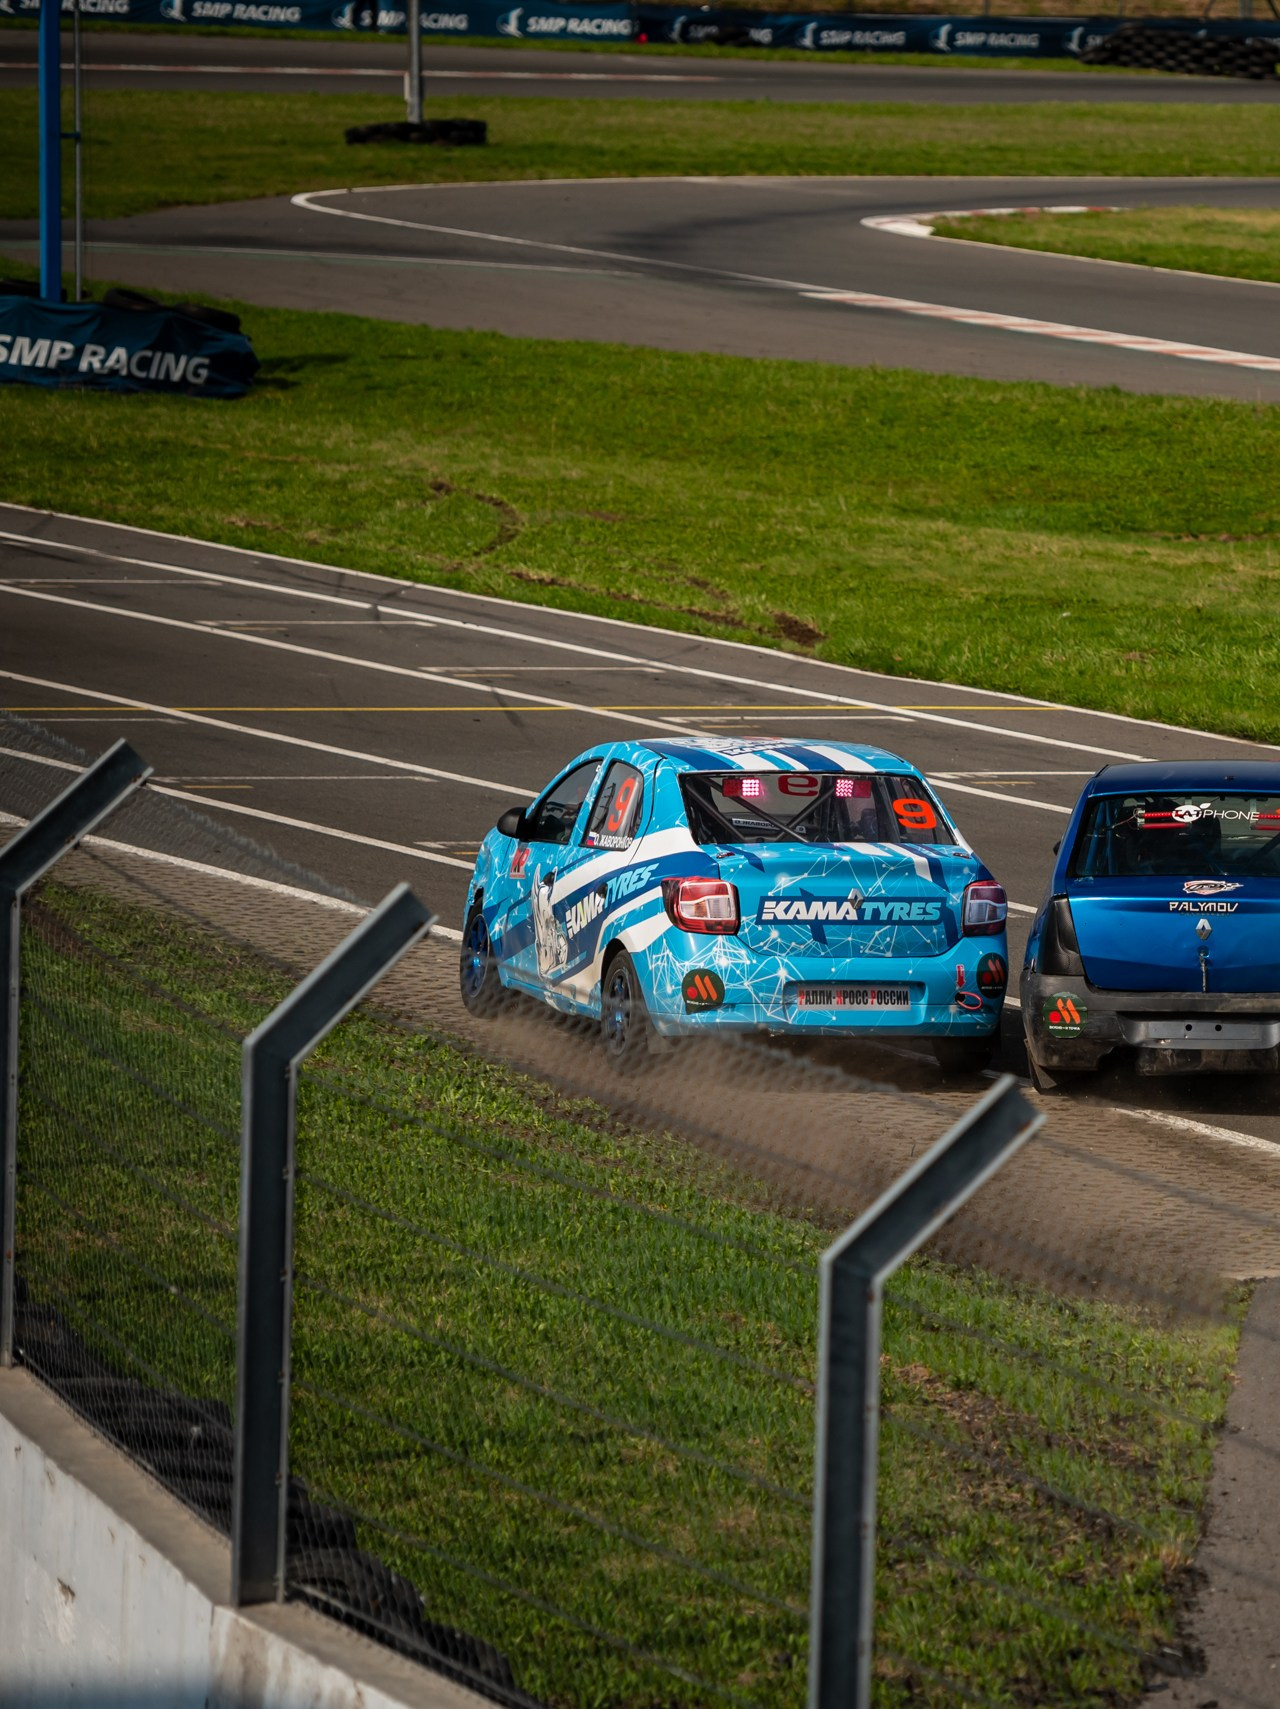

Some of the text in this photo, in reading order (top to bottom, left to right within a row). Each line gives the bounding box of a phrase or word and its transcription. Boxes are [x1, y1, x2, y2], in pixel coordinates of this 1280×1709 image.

[192, 1, 301, 22] SMP RACING
[360, 10, 467, 30] SMP ACING
[527, 17, 632, 36] SMP RACING
[819, 30, 905, 46] SMP RACING
[954, 32, 1039, 48] SMP RACING
[78, 343, 210, 385] RACING
[607, 777, 635, 832] 9
[892, 798, 936, 829] 9
[604, 862, 659, 908] TYRES
[762, 901, 941, 921] KAMA TYRES
[1169, 902, 1238, 912] PALYMOV
[799, 990, 909, 1005] РАЛЛИ-КРОСС РОССИИ
